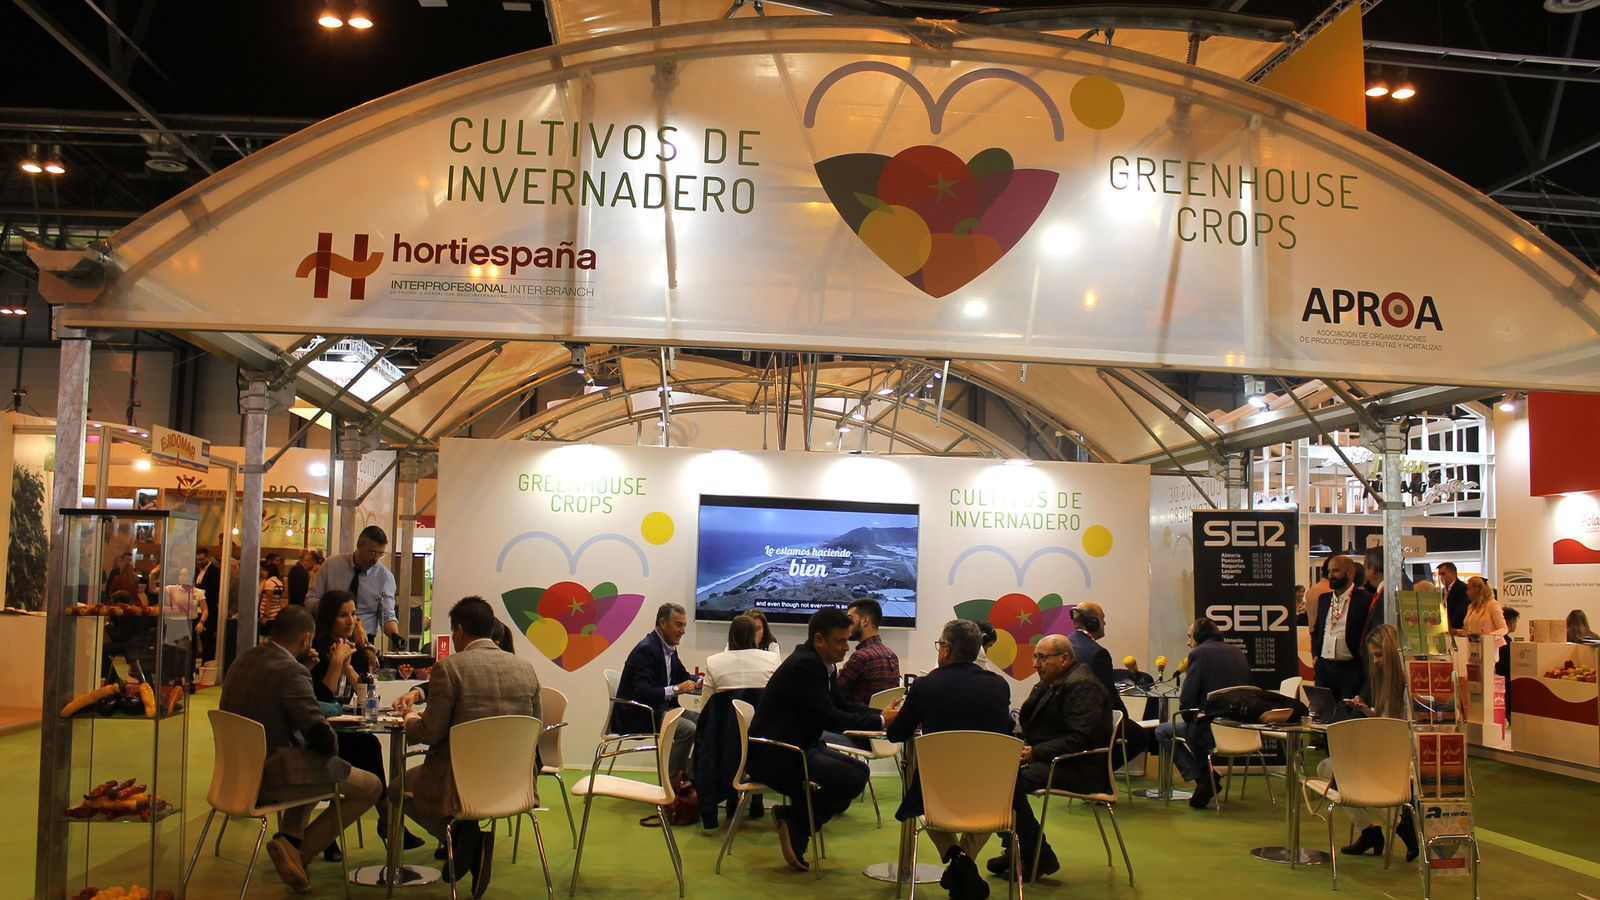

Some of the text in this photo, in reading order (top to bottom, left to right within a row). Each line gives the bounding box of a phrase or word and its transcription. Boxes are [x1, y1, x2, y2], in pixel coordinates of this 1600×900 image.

[449, 117, 761, 167] CULTIVOS DE
[446, 165, 755, 214] INVERNADERO
[1110, 155, 1359, 210] GREENHOUSE
[1177, 206, 1297, 250] CROPS
[392, 233, 597, 275] hortiespaña
[390, 279, 595, 298] INTERPROFESIONAL INTER-BRANCH
[1302, 287, 1443, 331] APROA
[1311, 336, 1361, 347] PRODUCTORES
[1372, 341, 1397, 349] FRUTAS
[1403, 343, 1443, 351] HORTALIZAS
[1316, 329, 1358, 338] ASOCIACIÓN
[1369, 332, 1427, 342] ORGANIZACIONES
[160, 433, 196, 460] EJIDOMAR
[269, 485, 299, 498] BIO
[1058, 491, 1082, 509] DE
[551, 494, 613, 514] CROPS
[950, 510, 1081, 531] INVERNADERO
[1203, 520, 1287, 547] SER
[764, 545, 852, 558] Lo estamos haciendo
[788, 559, 828, 577] bien
[1503, 584, 1533, 597] KOWR
[1206, 605, 1290, 632] SER
